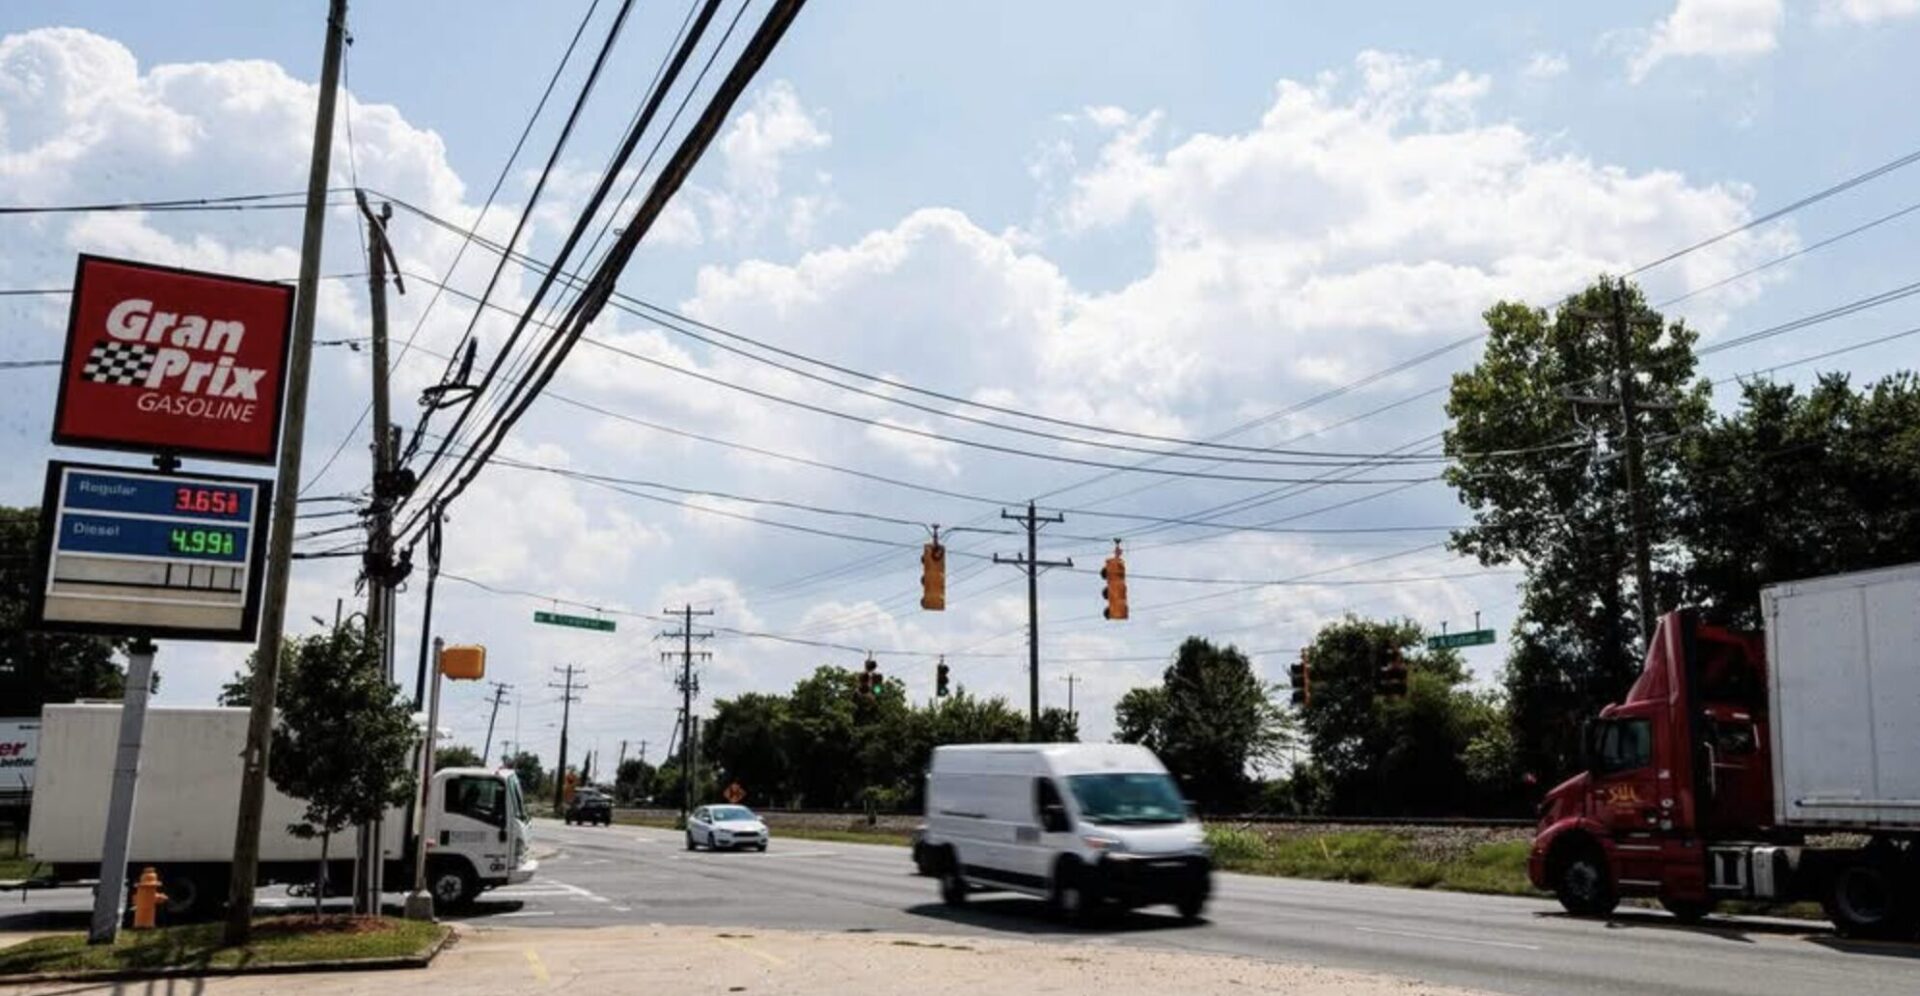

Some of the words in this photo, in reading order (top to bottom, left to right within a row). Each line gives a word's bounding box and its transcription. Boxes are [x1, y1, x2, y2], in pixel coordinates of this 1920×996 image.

[106, 299, 245, 354] Gran
[145, 348, 267, 400] Prix
[137, 391, 257, 423] GASOLINE
[79, 480, 137, 496] Regular
[73, 521, 121, 536] Diesel
